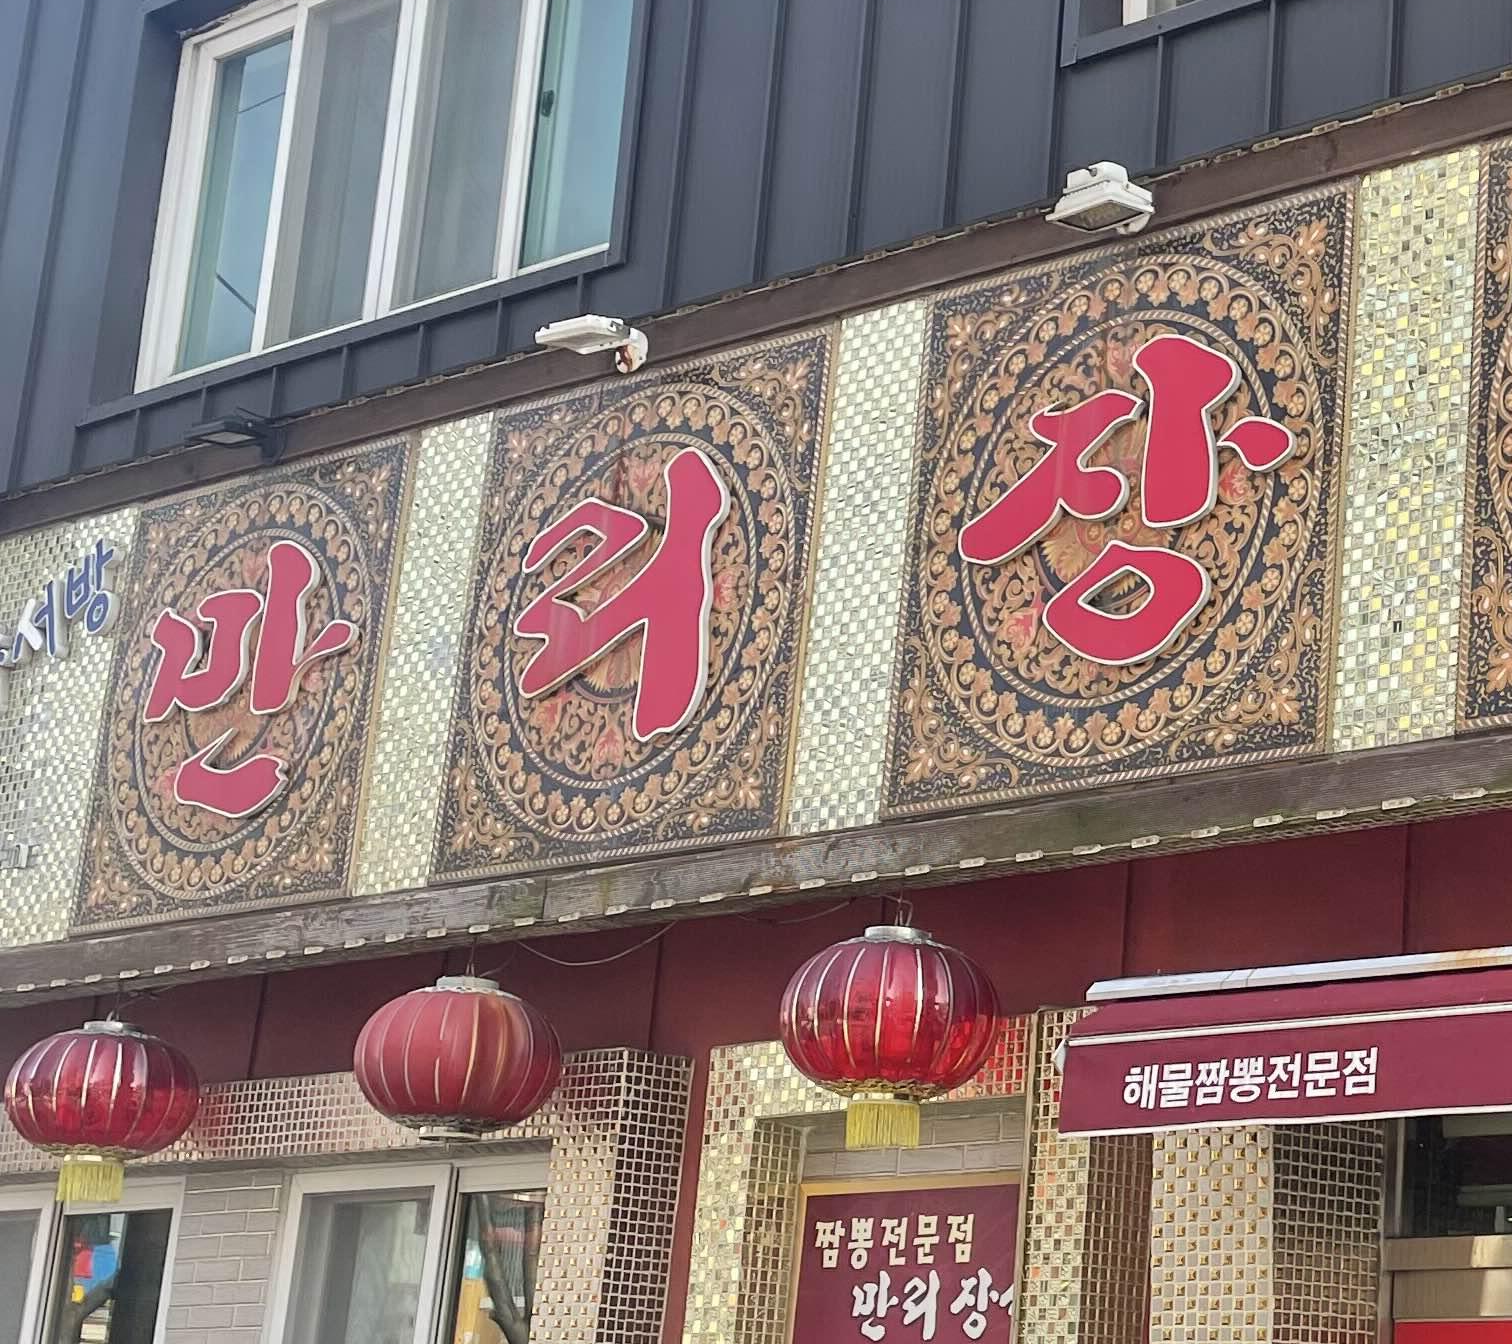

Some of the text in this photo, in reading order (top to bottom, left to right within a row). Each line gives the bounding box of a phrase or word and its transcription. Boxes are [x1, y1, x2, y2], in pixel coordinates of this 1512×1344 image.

[0, 538, 113, 666] 서방
[1123, 1047, 1379, 1109] 해물짬뽕전문점
[815, 1214, 975, 1269] 짬뽕전문점
